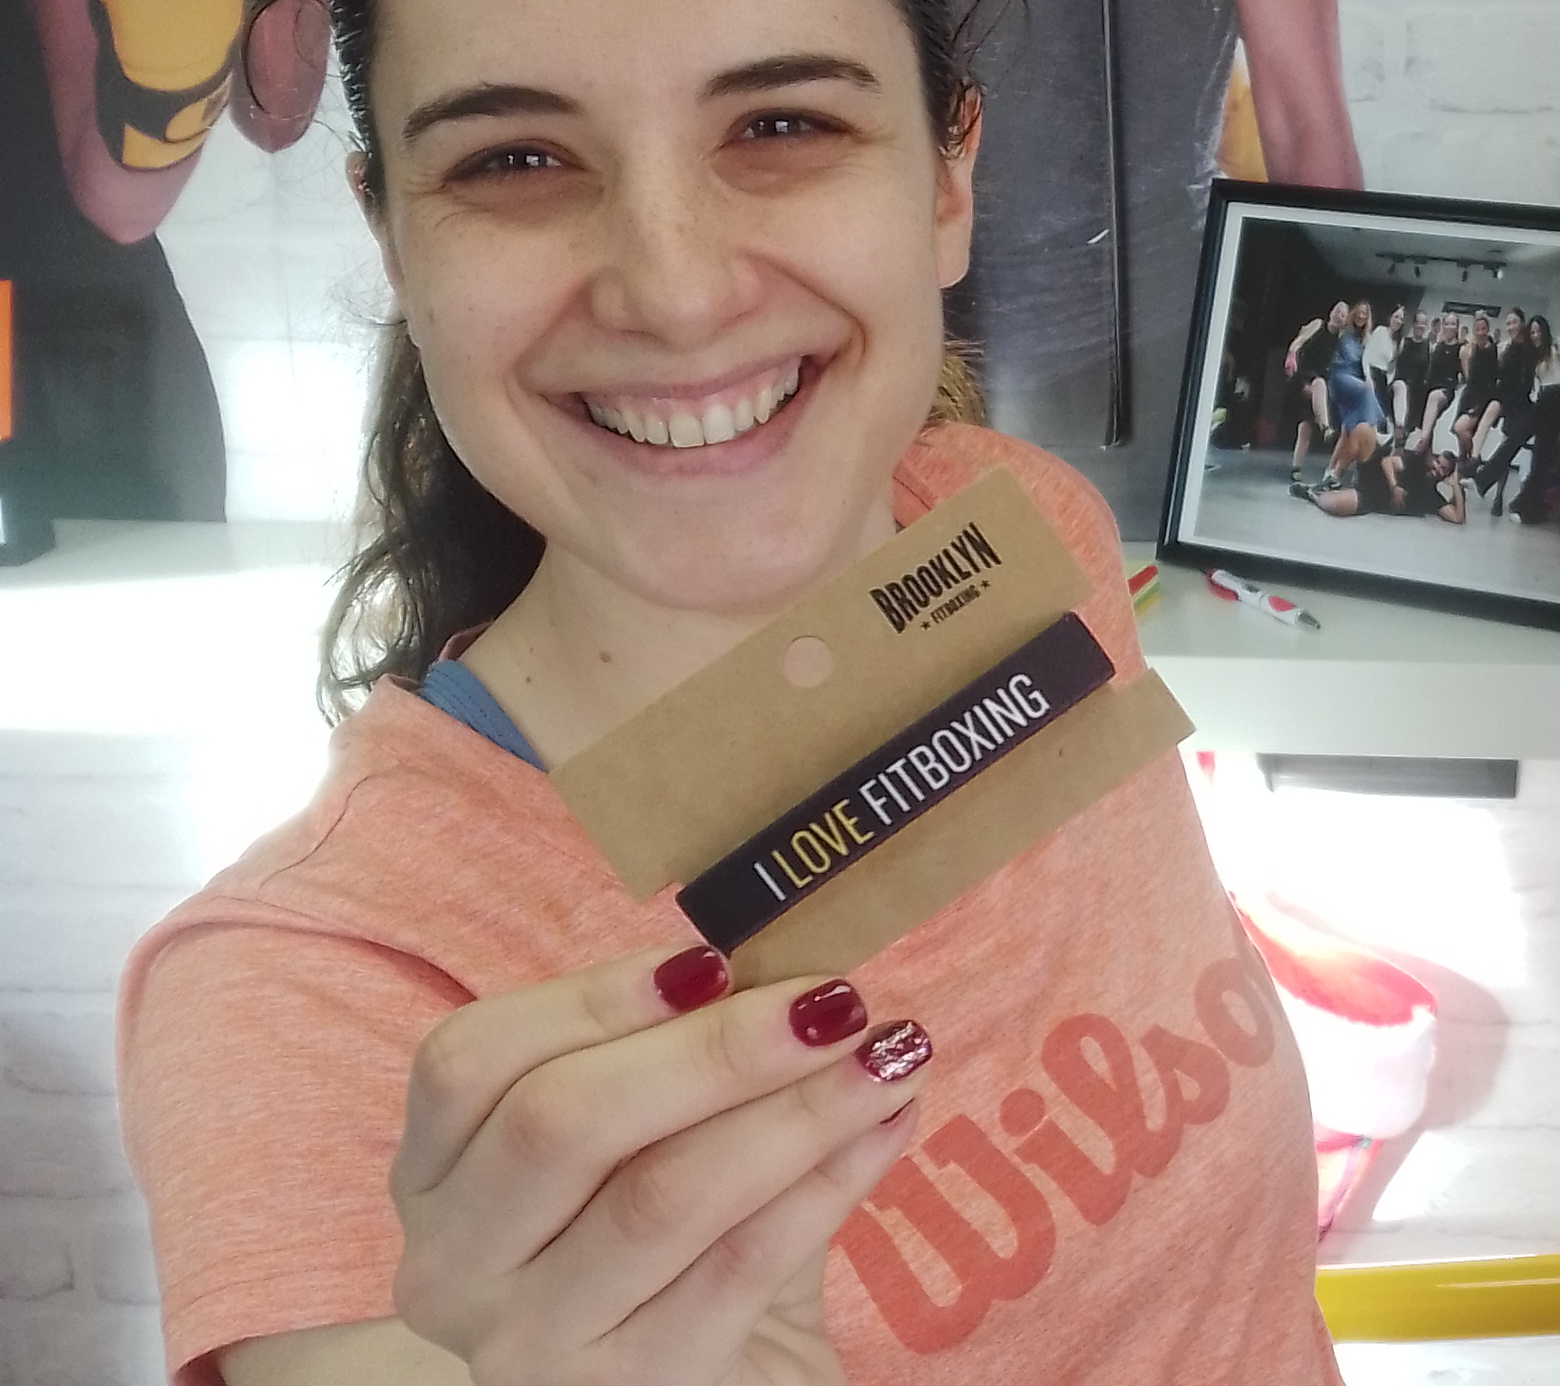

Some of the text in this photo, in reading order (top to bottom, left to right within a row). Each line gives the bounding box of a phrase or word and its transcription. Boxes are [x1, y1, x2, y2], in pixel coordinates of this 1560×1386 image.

[869, 520, 1003, 634] BROOKLYN
[752, 673, 1052, 901] I LOVE FITBOXING
[828, 955, 1286, 1355] Wilso
